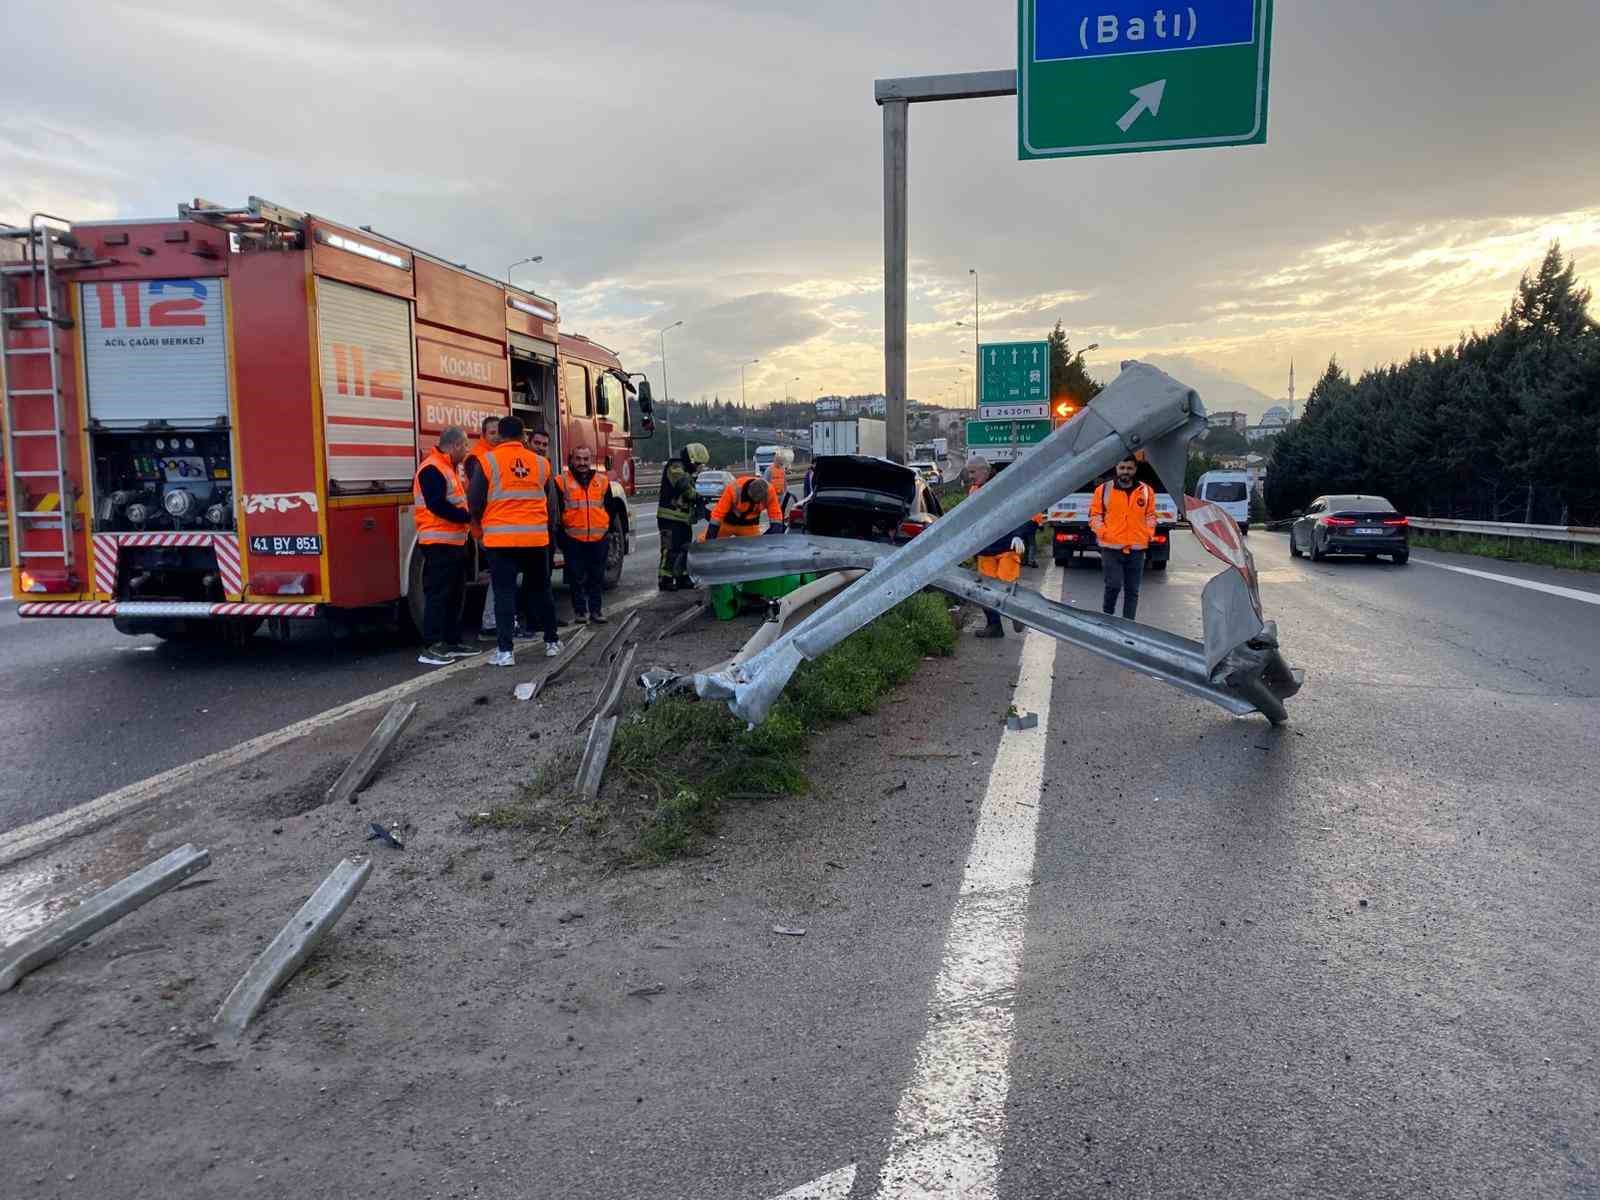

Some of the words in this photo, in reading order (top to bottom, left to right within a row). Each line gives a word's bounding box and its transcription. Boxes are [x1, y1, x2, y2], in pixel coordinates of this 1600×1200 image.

[1079, 7, 1197, 50] (Batı)
[97, 280, 207, 328] 112
[253, 537, 268, 550] 41
[273, 537, 291, 550] BY
[296, 537, 318, 550] 851
